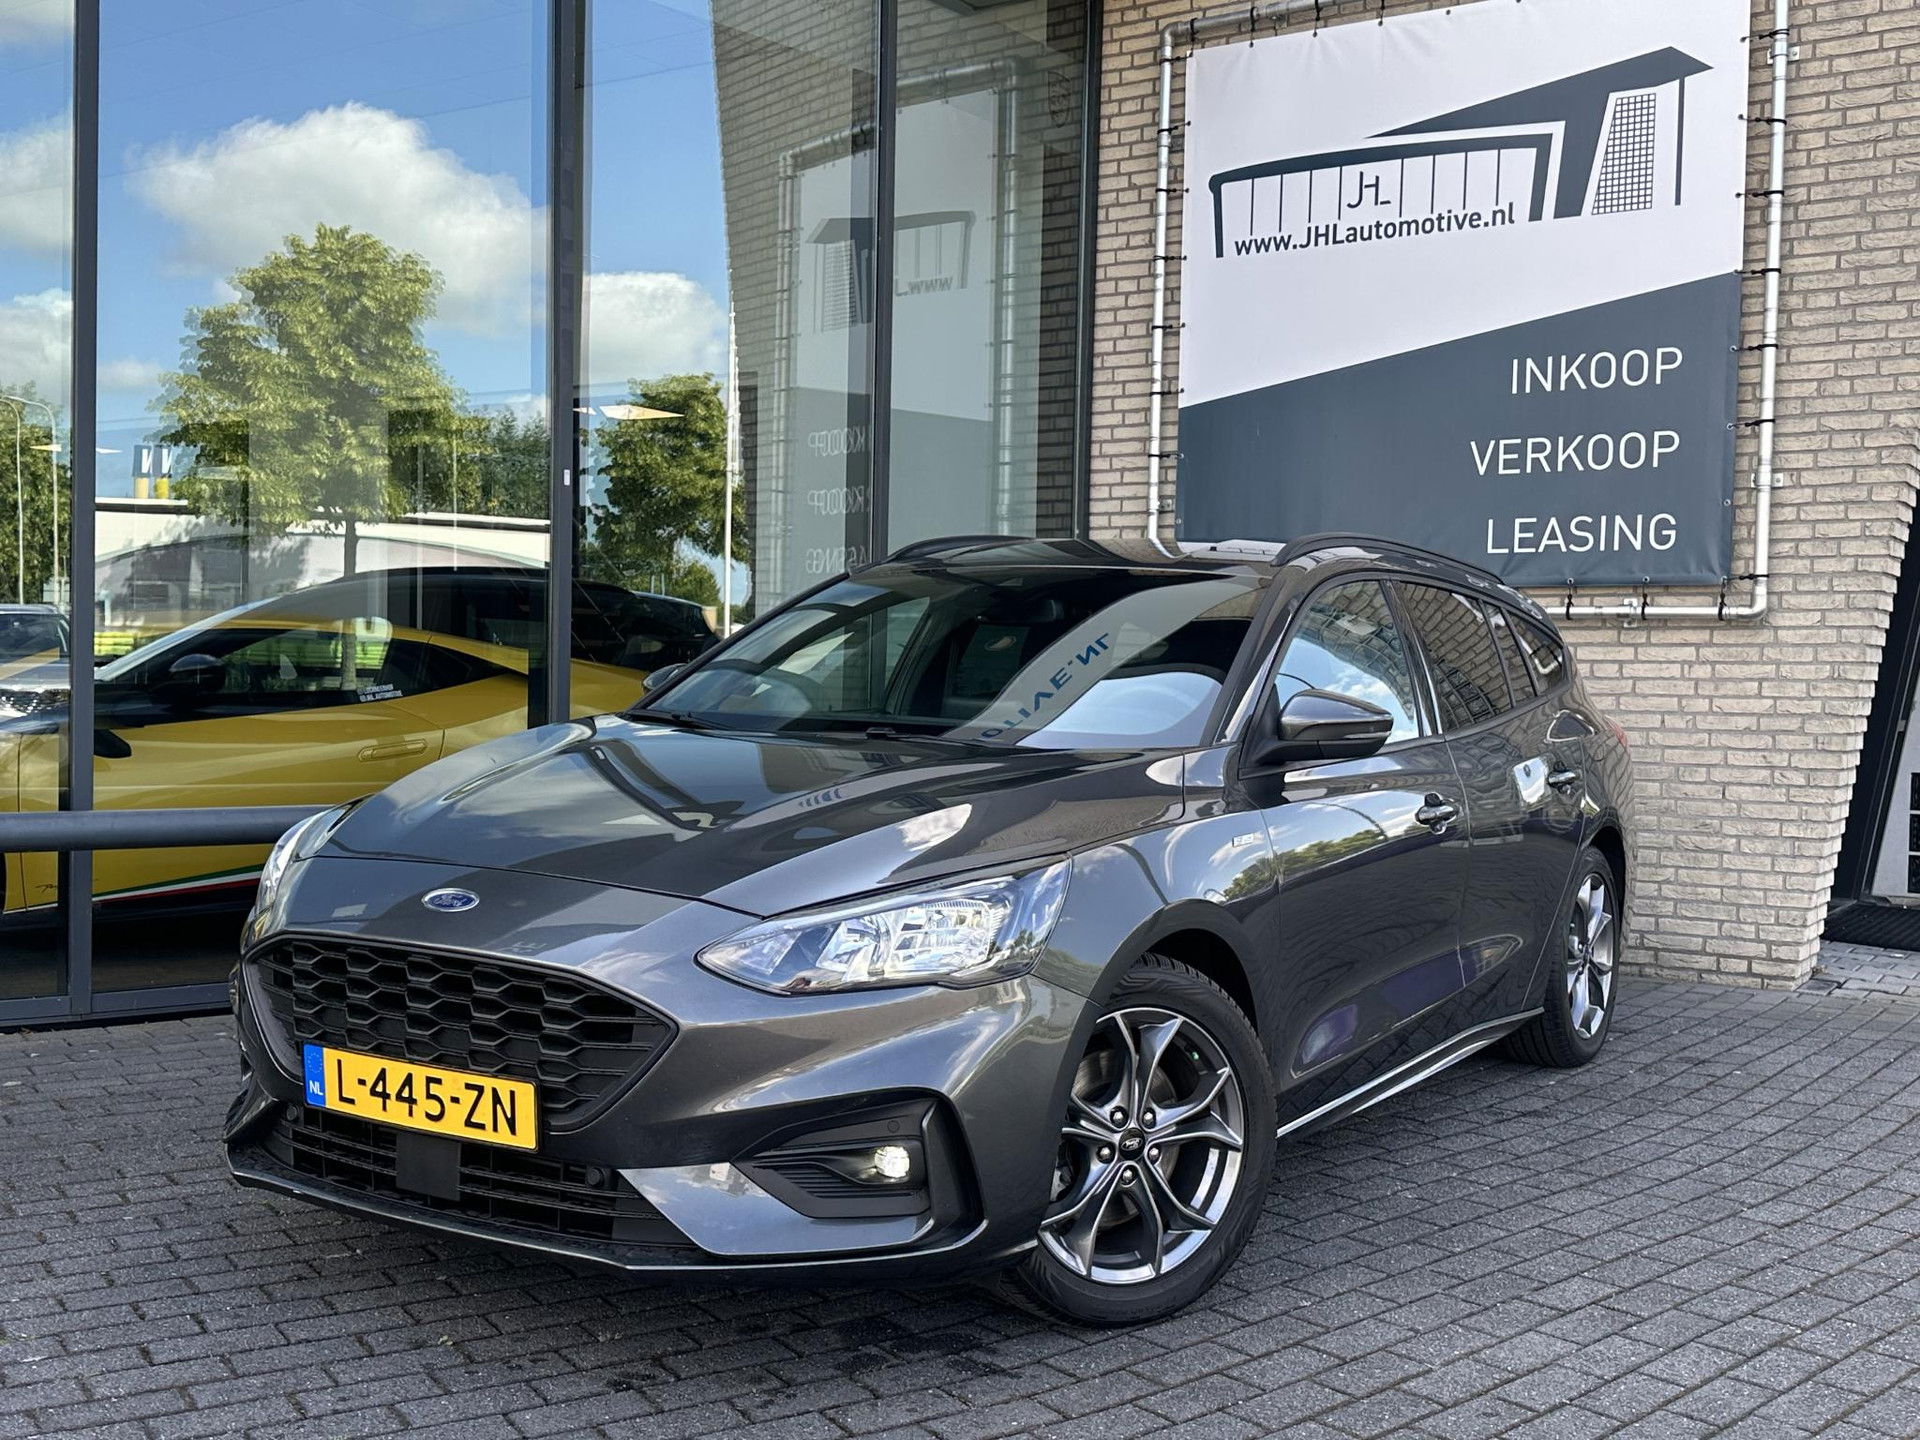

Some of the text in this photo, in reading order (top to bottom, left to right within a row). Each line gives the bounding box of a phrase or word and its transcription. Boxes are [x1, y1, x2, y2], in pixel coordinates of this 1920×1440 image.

[1346, 171, 1392, 209] JHL
[1234, 201, 1516, 257] www.JHLautomotive.nl
[1511, 346, 1683, 395] INKOOP
[1470, 430, 1680, 476] VERKOOP
[1487, 513, 1678, 556] LEASING
[309, 1080, 324, 1096] NL
[336, 1058, 517, 1137] L-445-ZN
